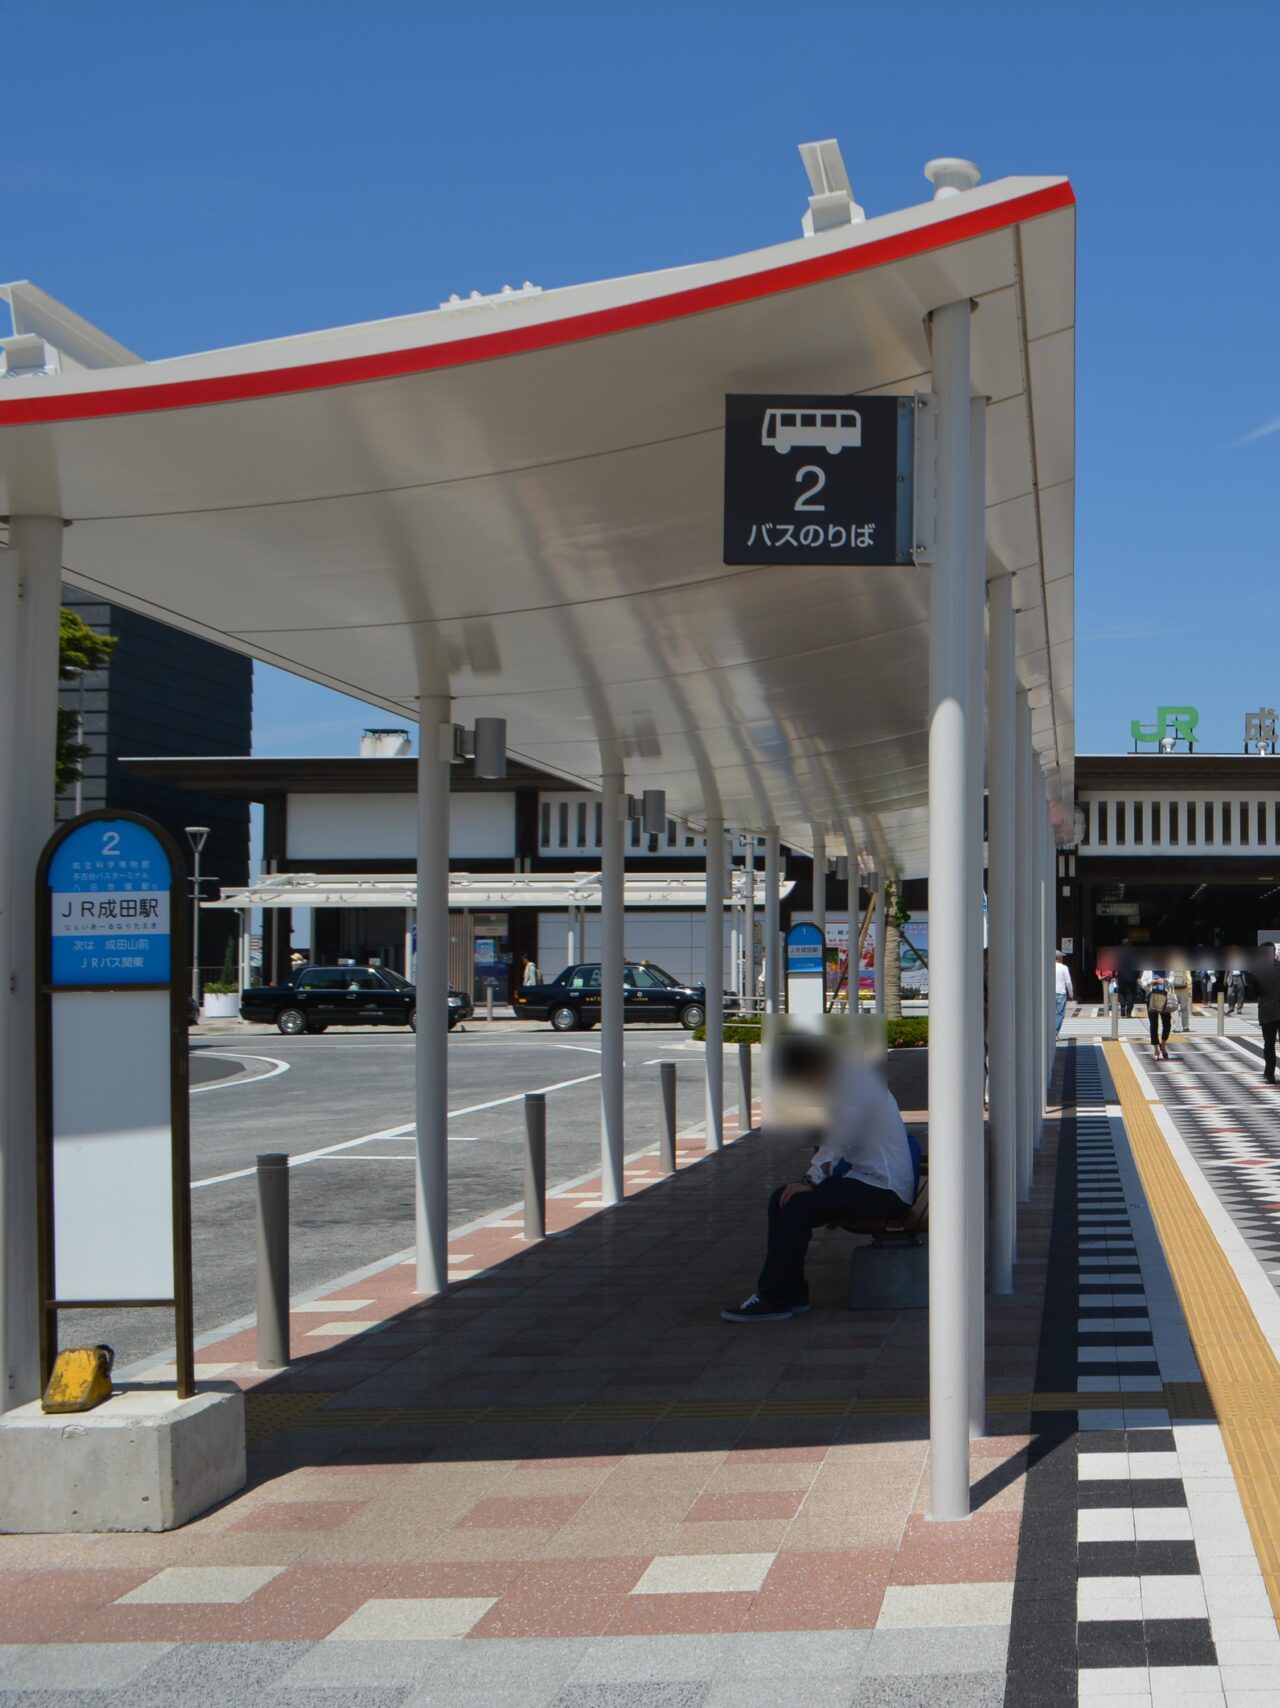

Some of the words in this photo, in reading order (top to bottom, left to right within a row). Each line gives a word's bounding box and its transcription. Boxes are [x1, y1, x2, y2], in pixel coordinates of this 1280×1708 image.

[794, 465, 826, 511] 2
[747, 523, 876, 548] バスのりば
[1130, 706, 1199, 742] JR
[102, 832, 120, 855] 2
[62, 898, 159, 918] JR成田駅
[73, 940, 94, 951] 次は
[105, 939, 149, 950] 成田山前
[80, 957, 143, 968] JRバス関東
